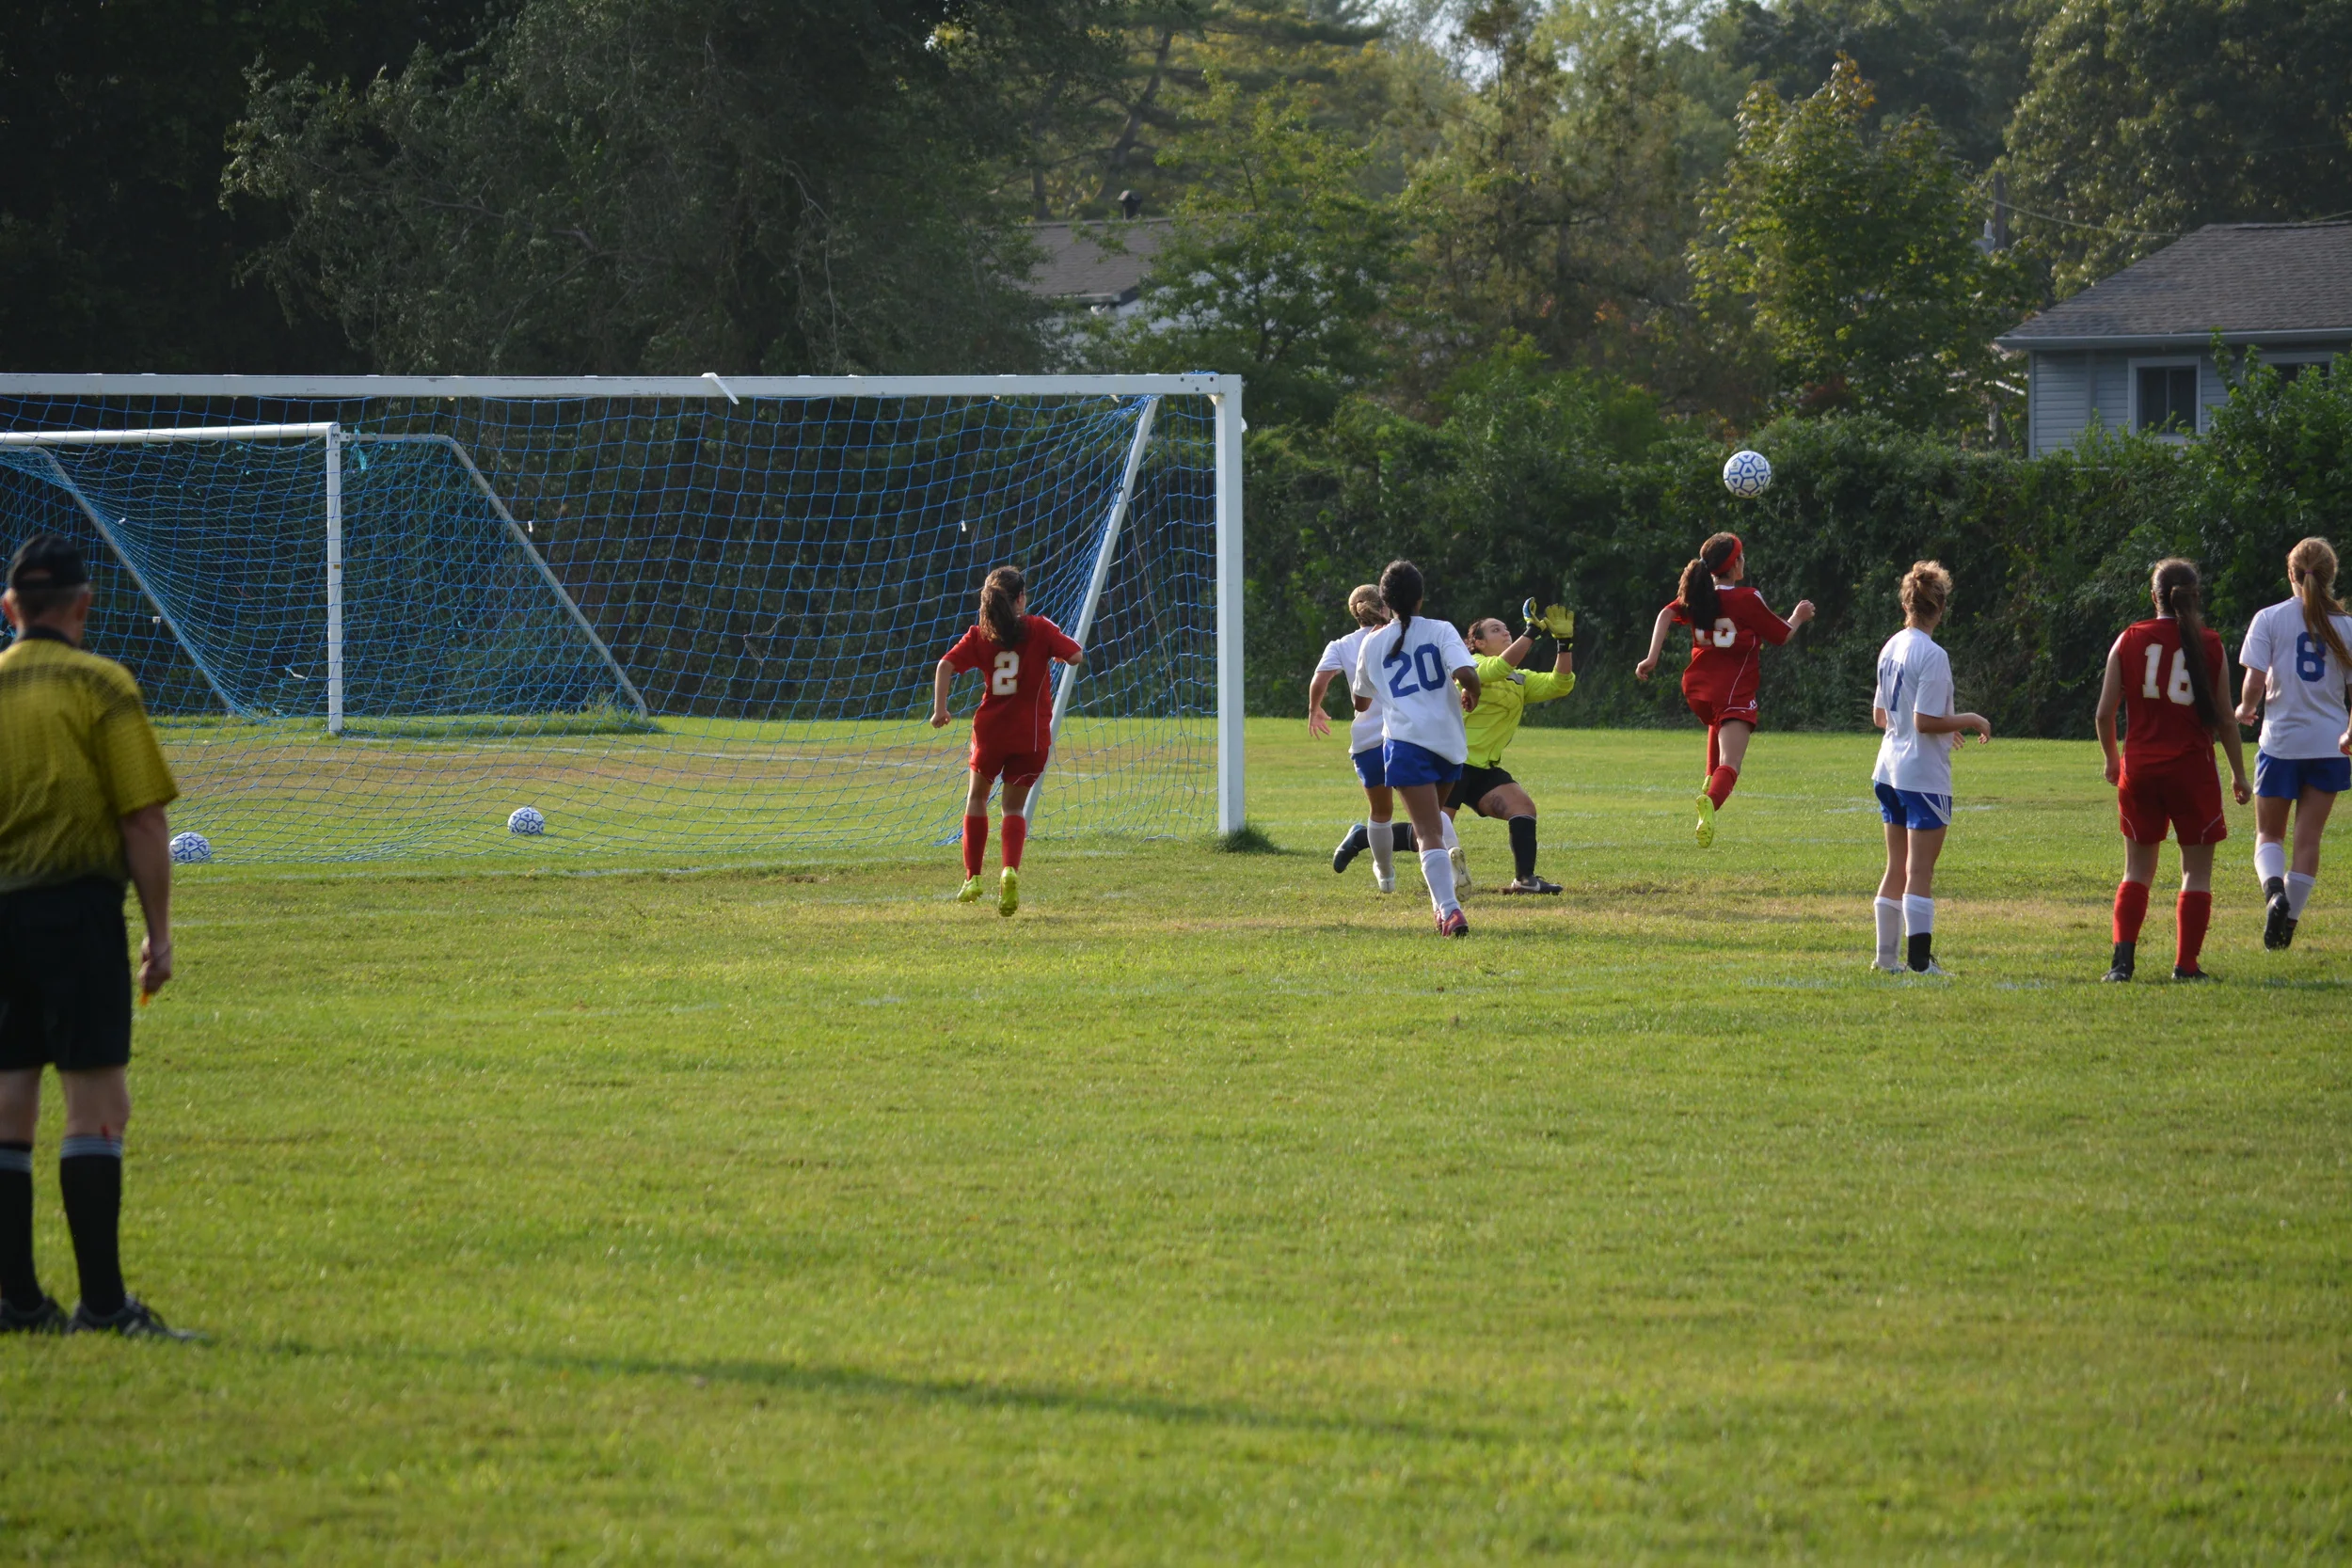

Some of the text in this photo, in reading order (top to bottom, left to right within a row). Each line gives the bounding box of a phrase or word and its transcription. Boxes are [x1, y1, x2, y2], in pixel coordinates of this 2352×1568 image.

[993, 651, 1019, 696] 2
[1383, 643, 1446, 698] 20
[2142, 643, 2195, 705] 16
[2296, 631, 2326, 682] 8
